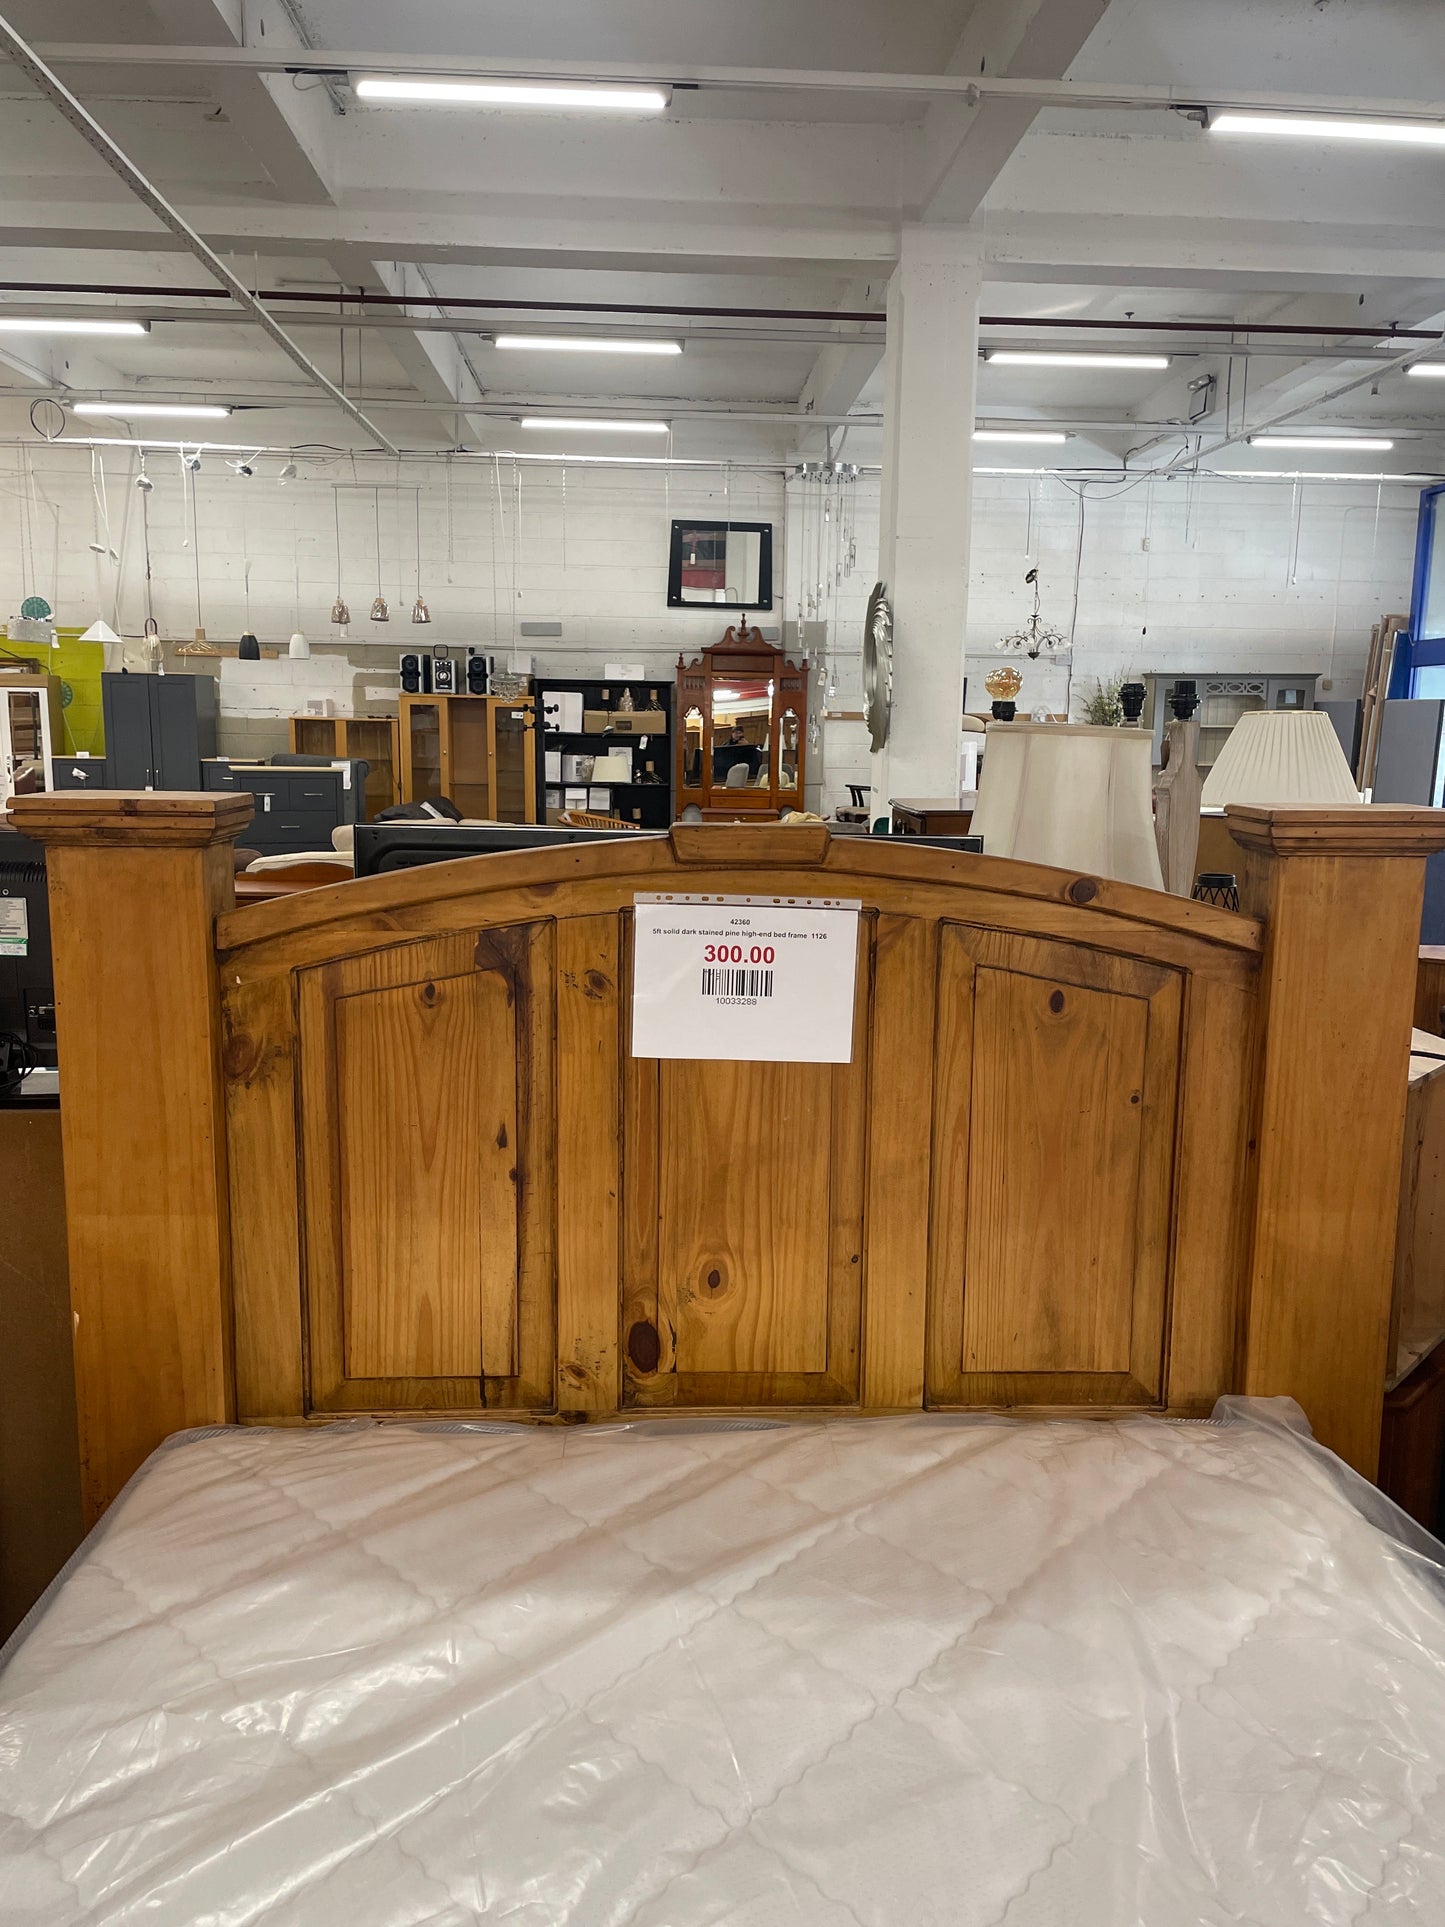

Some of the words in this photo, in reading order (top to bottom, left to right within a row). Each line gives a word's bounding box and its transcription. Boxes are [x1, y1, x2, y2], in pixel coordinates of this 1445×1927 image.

[730, 918, 751, 926] 42360
[741, 930, 772, 938] high-end
[704, 944, 775, 964] 300.00
[716, 997, 757, 1006] 10033288
